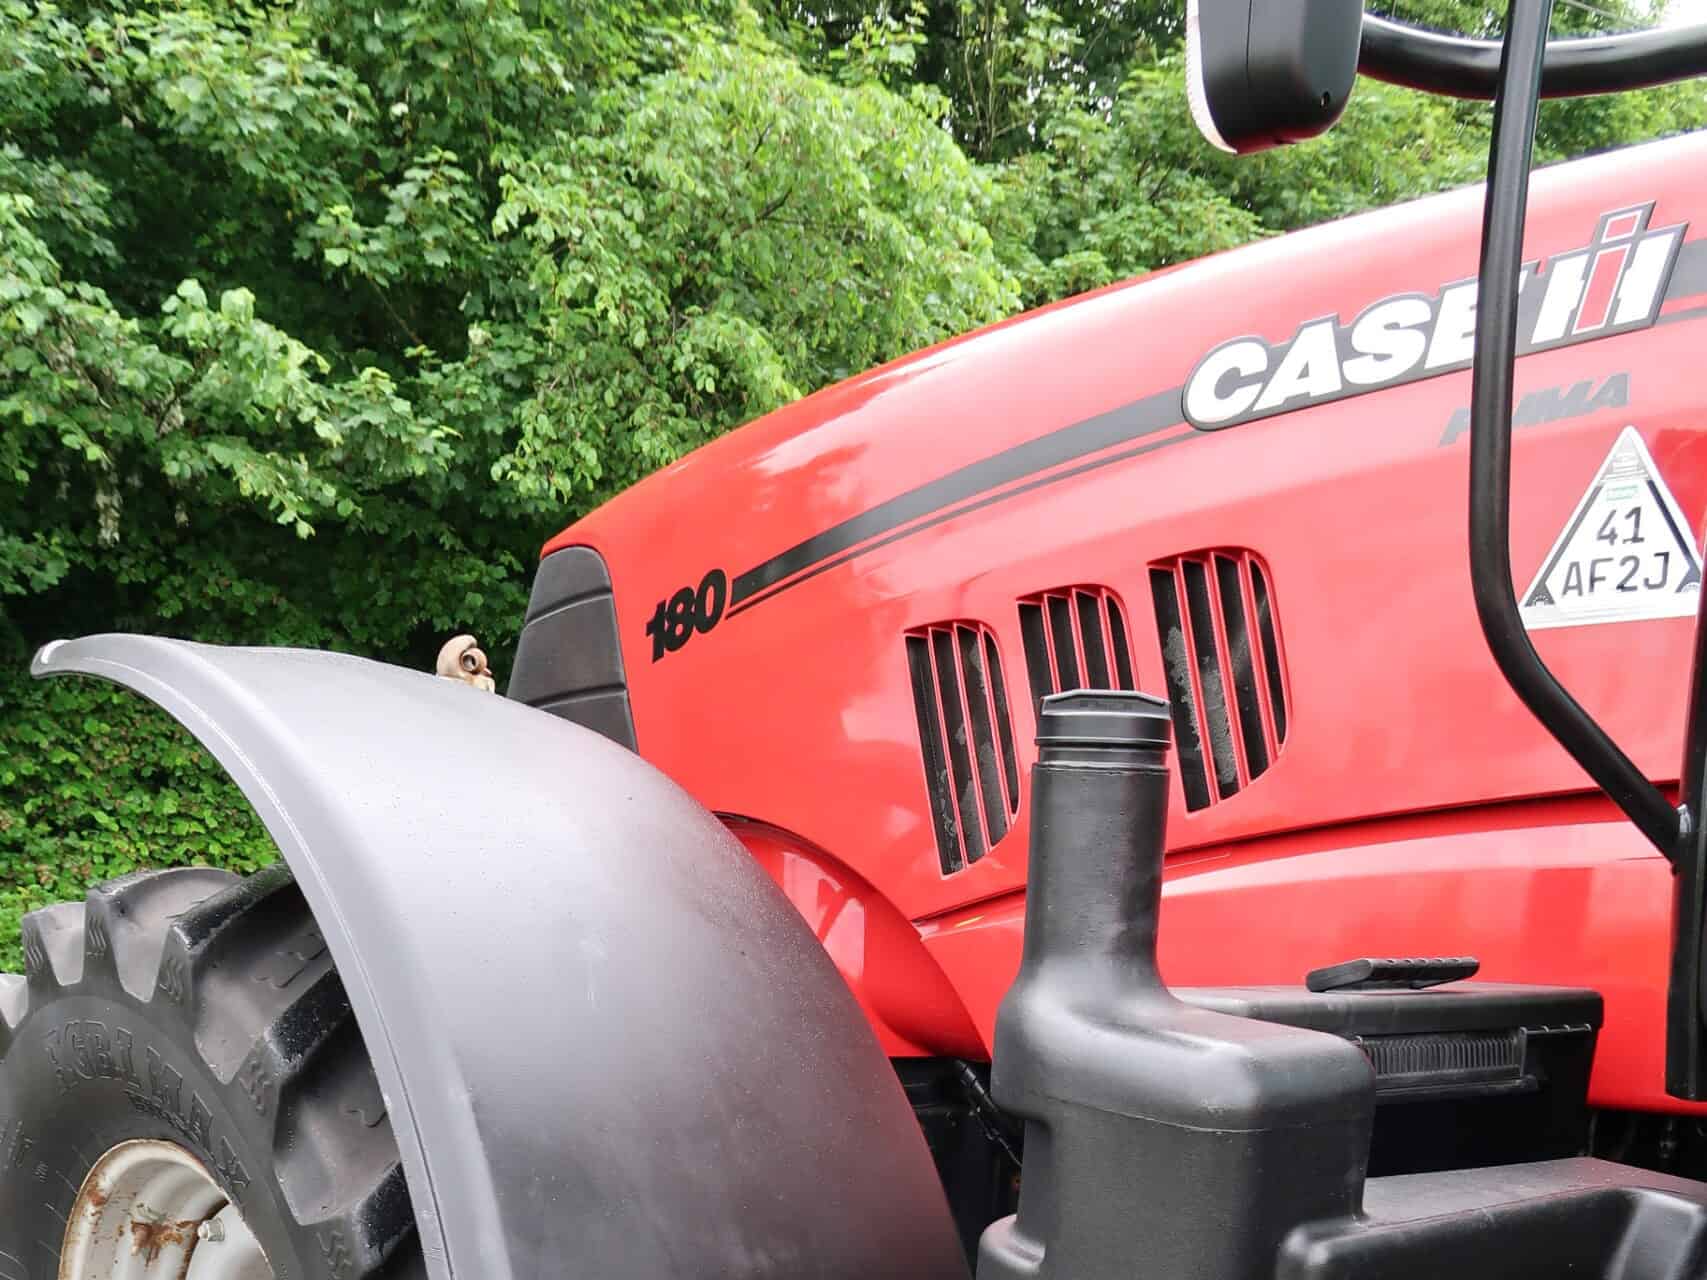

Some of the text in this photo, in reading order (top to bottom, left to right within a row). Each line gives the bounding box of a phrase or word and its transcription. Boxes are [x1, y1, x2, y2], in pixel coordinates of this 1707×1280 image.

[1596, 505, 1645, 546] 41
[1561, 551, 1671, 597] AF2J
[646, 568, 727, 664] 180
